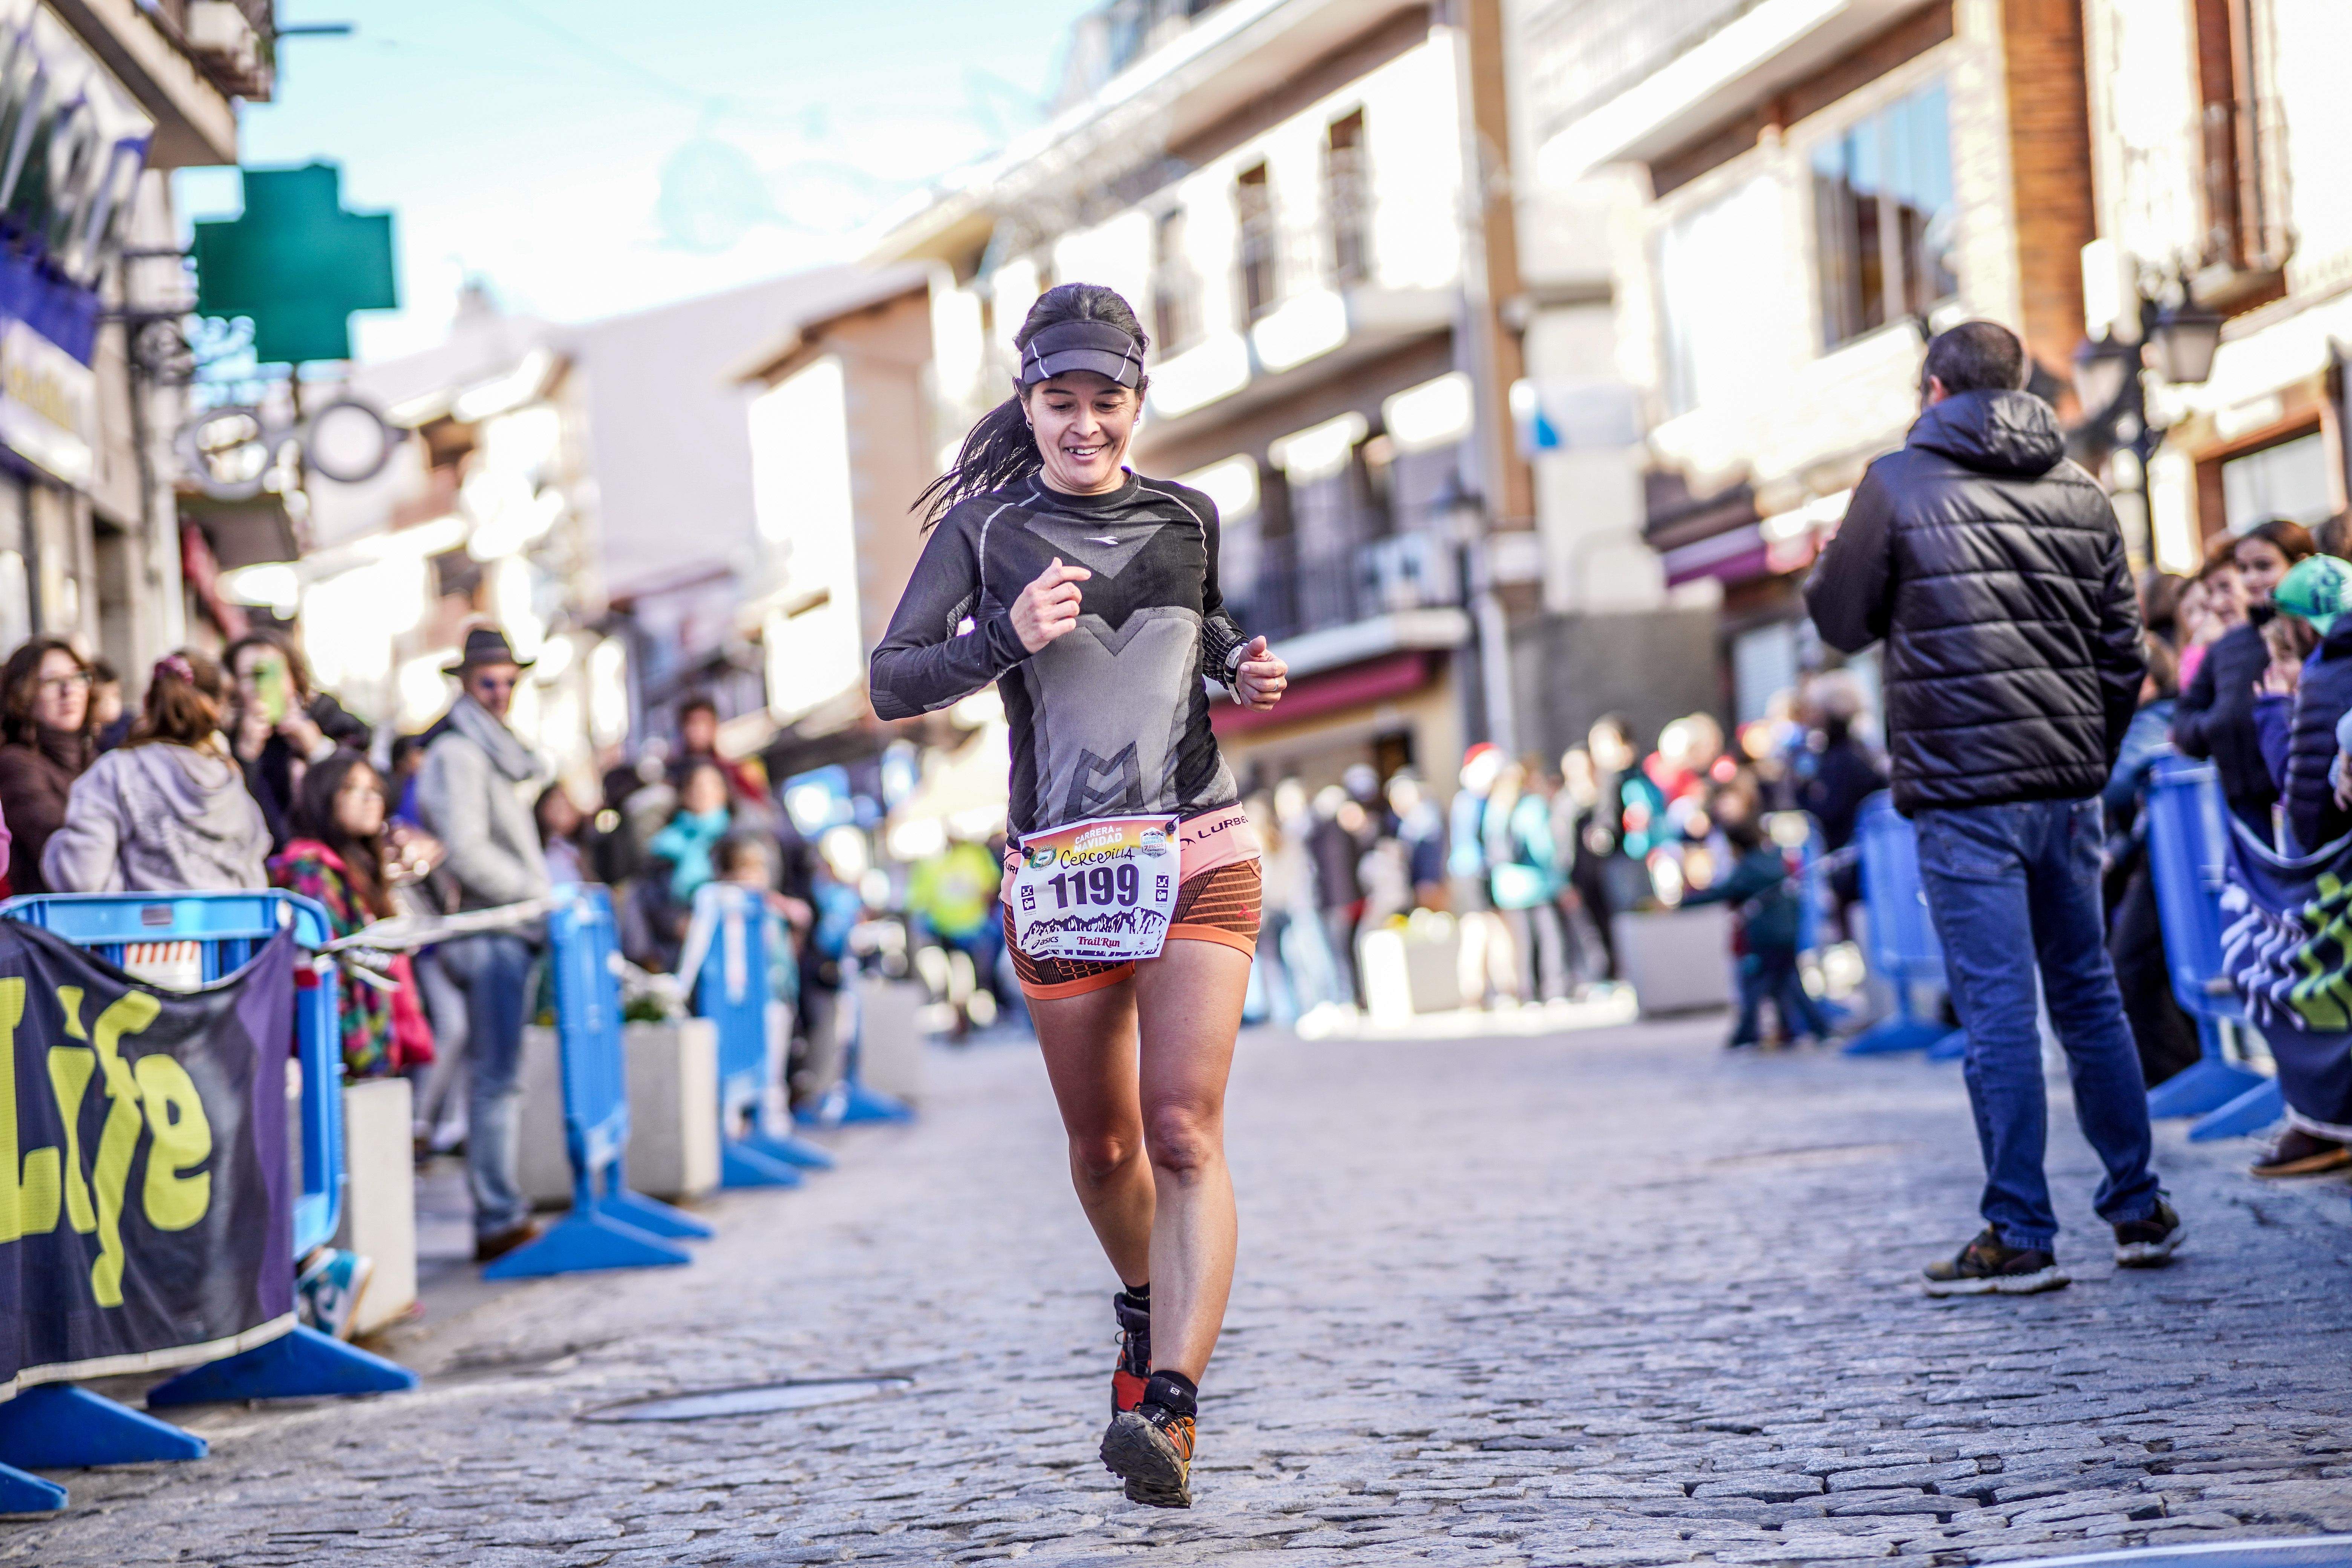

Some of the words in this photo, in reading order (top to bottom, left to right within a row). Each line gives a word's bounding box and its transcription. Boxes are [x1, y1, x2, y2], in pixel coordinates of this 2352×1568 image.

[1074, 833, 1122, 853] NAVIDAD
[1075, 825, 1114, 845] CARRERA
[1048, 864, 1139, 909] 1199
[1076, 936, 1101, 946] Trail
[1101, 937, 1120, 948] Run
[0, 977, 211, 1307] Life
